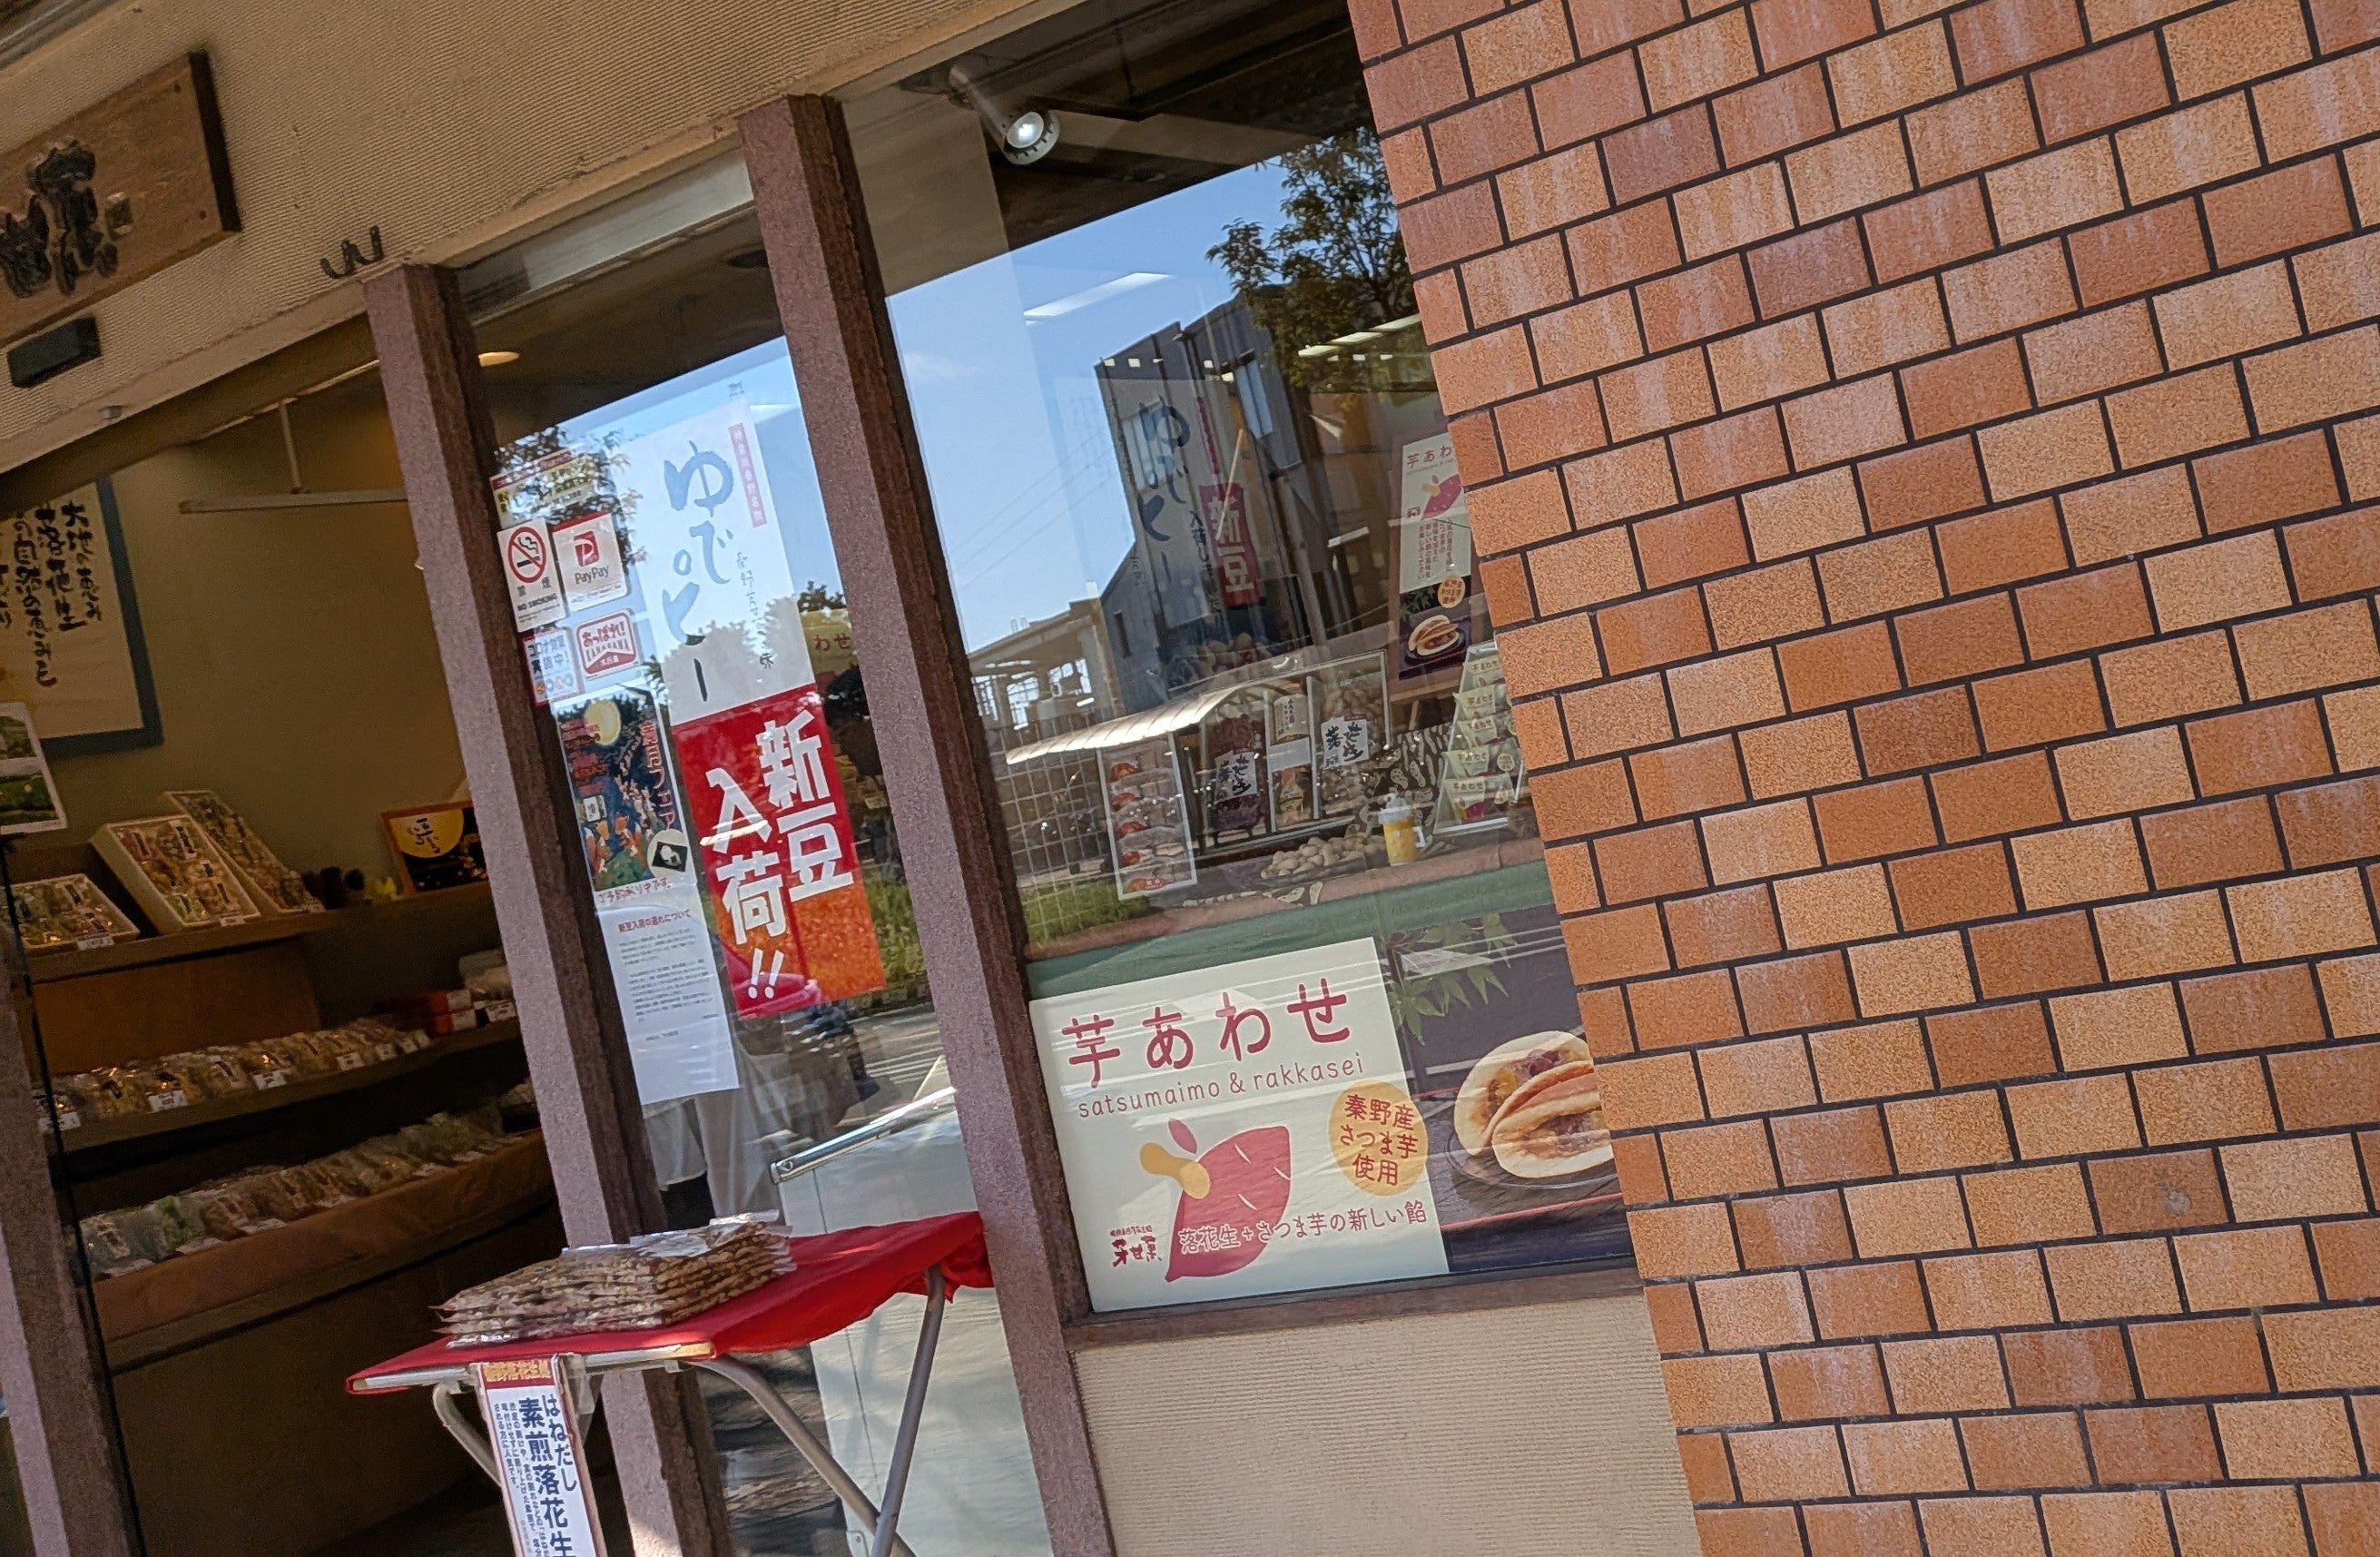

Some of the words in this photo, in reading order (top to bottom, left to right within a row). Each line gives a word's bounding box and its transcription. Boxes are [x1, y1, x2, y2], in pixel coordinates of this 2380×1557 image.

[575, 565, 609, 585] PayPay
[663, 439, 734, 703] ゆでピー
[756, 709, 853, 902] 新豆
[1061, 977, 1351, 1089] 芋あわせ
[1077, 1079, 1221, 1118] satsumaimo
[1228, 1071, 1246, 1095] &
[1253, 1051, 1364, 1089] rakkasei
[1344, 1093, 1415, 1131] 秦野産
[1340, 1124, 1419, 1159] さつま芋
[1352, 1153, 1398, 1186] 使用
[518, 1397, 577, 1557] 素煎落花生
[542, 1394, 577, 1493] はねだし
